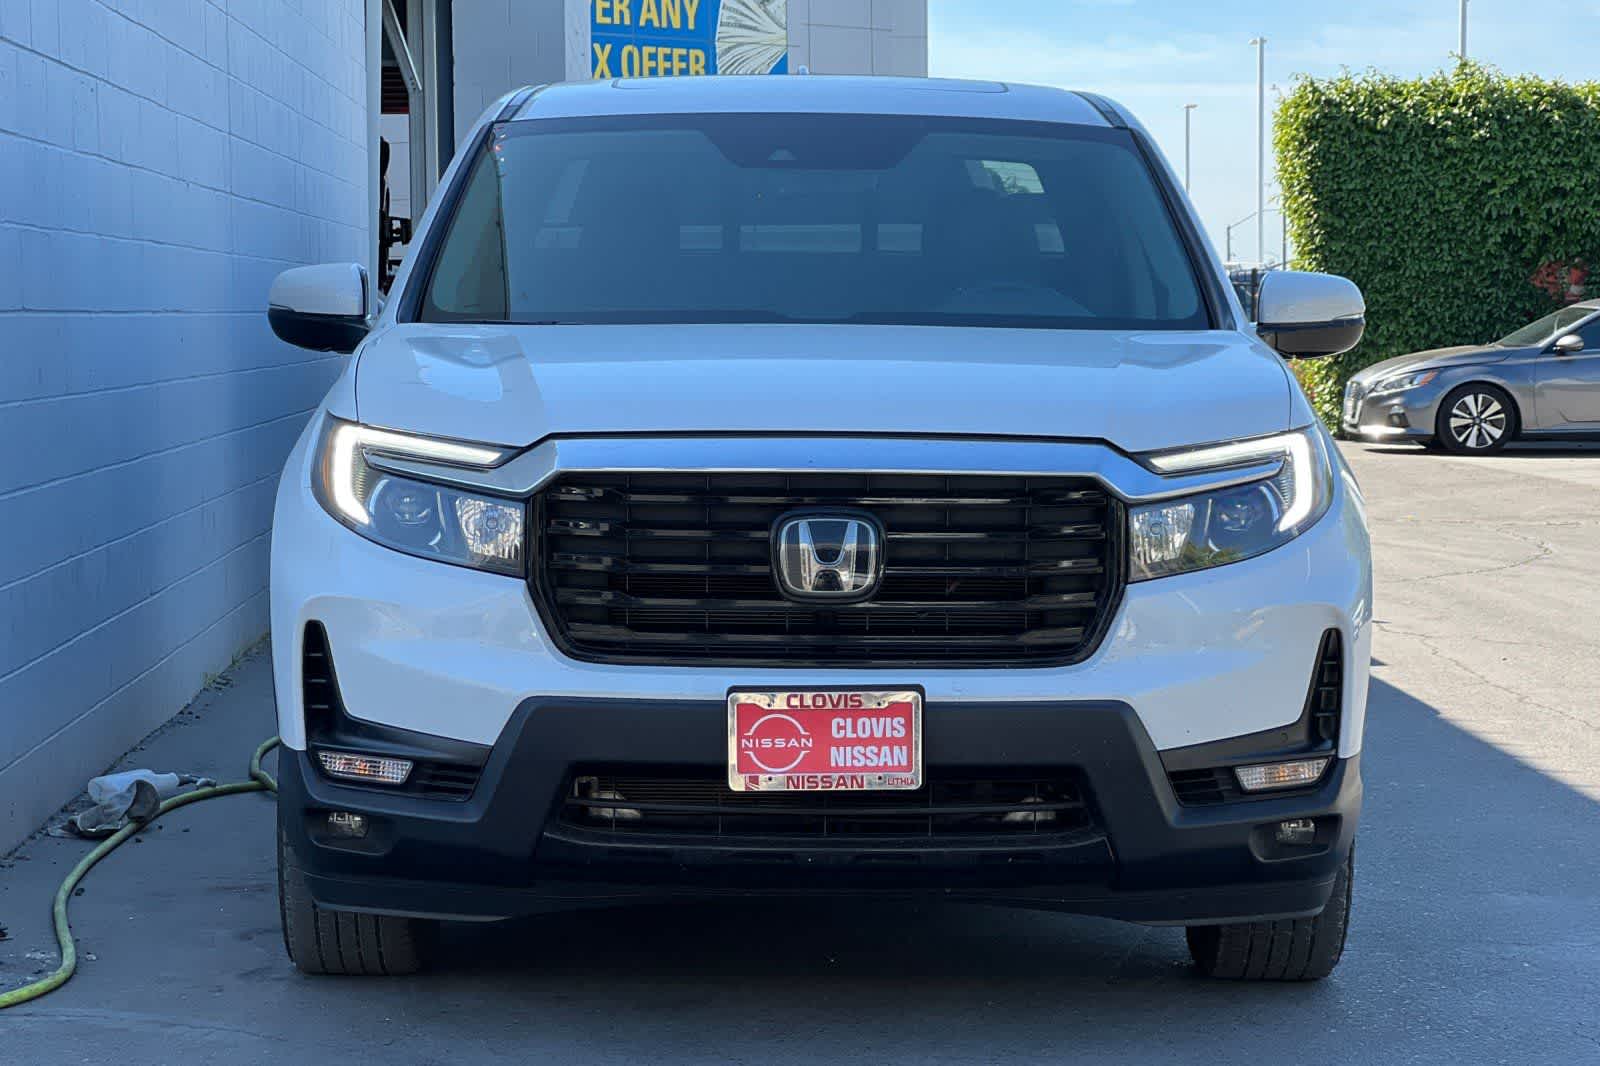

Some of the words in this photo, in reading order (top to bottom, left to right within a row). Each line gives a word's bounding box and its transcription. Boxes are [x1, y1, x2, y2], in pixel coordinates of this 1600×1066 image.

[639, 0, 699, 30] ANY
[621, 45, 706, 79] OFFER
[786, 693, 863, 708] CLOVIS
[831, 717, 906, 738] CLOVIS
[742, 738, 813, 748] NISSAN
[830, 746, 907, 767] NISSAN
[786, 775, 865, 789] NISSAN
[887, 777, 915, 786] LITHIA
